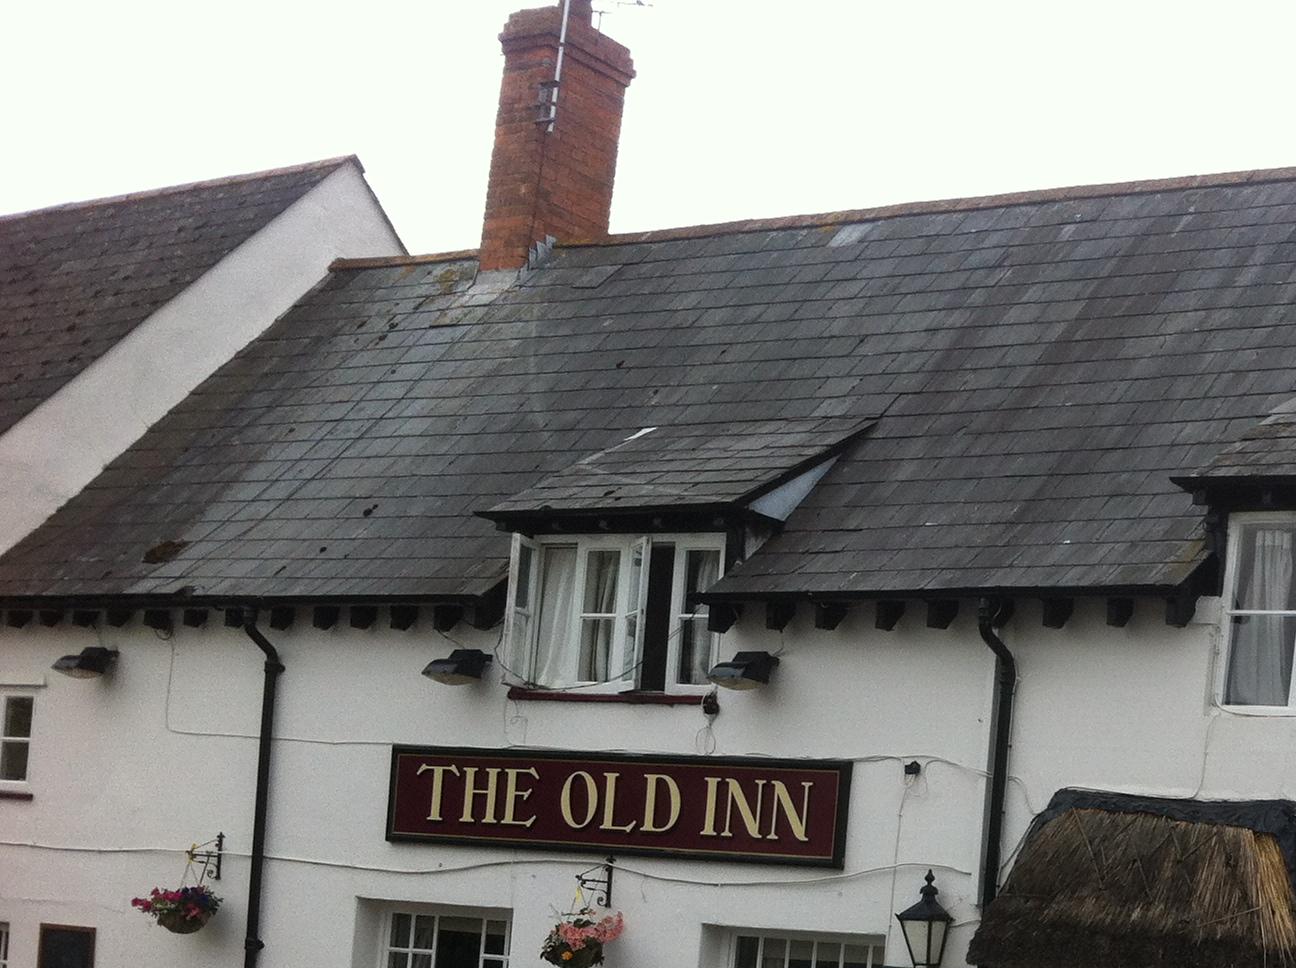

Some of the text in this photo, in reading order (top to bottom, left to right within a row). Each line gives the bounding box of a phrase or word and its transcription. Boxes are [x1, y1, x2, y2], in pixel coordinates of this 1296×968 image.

[416, 763, 814, 841] THE OLD INN
